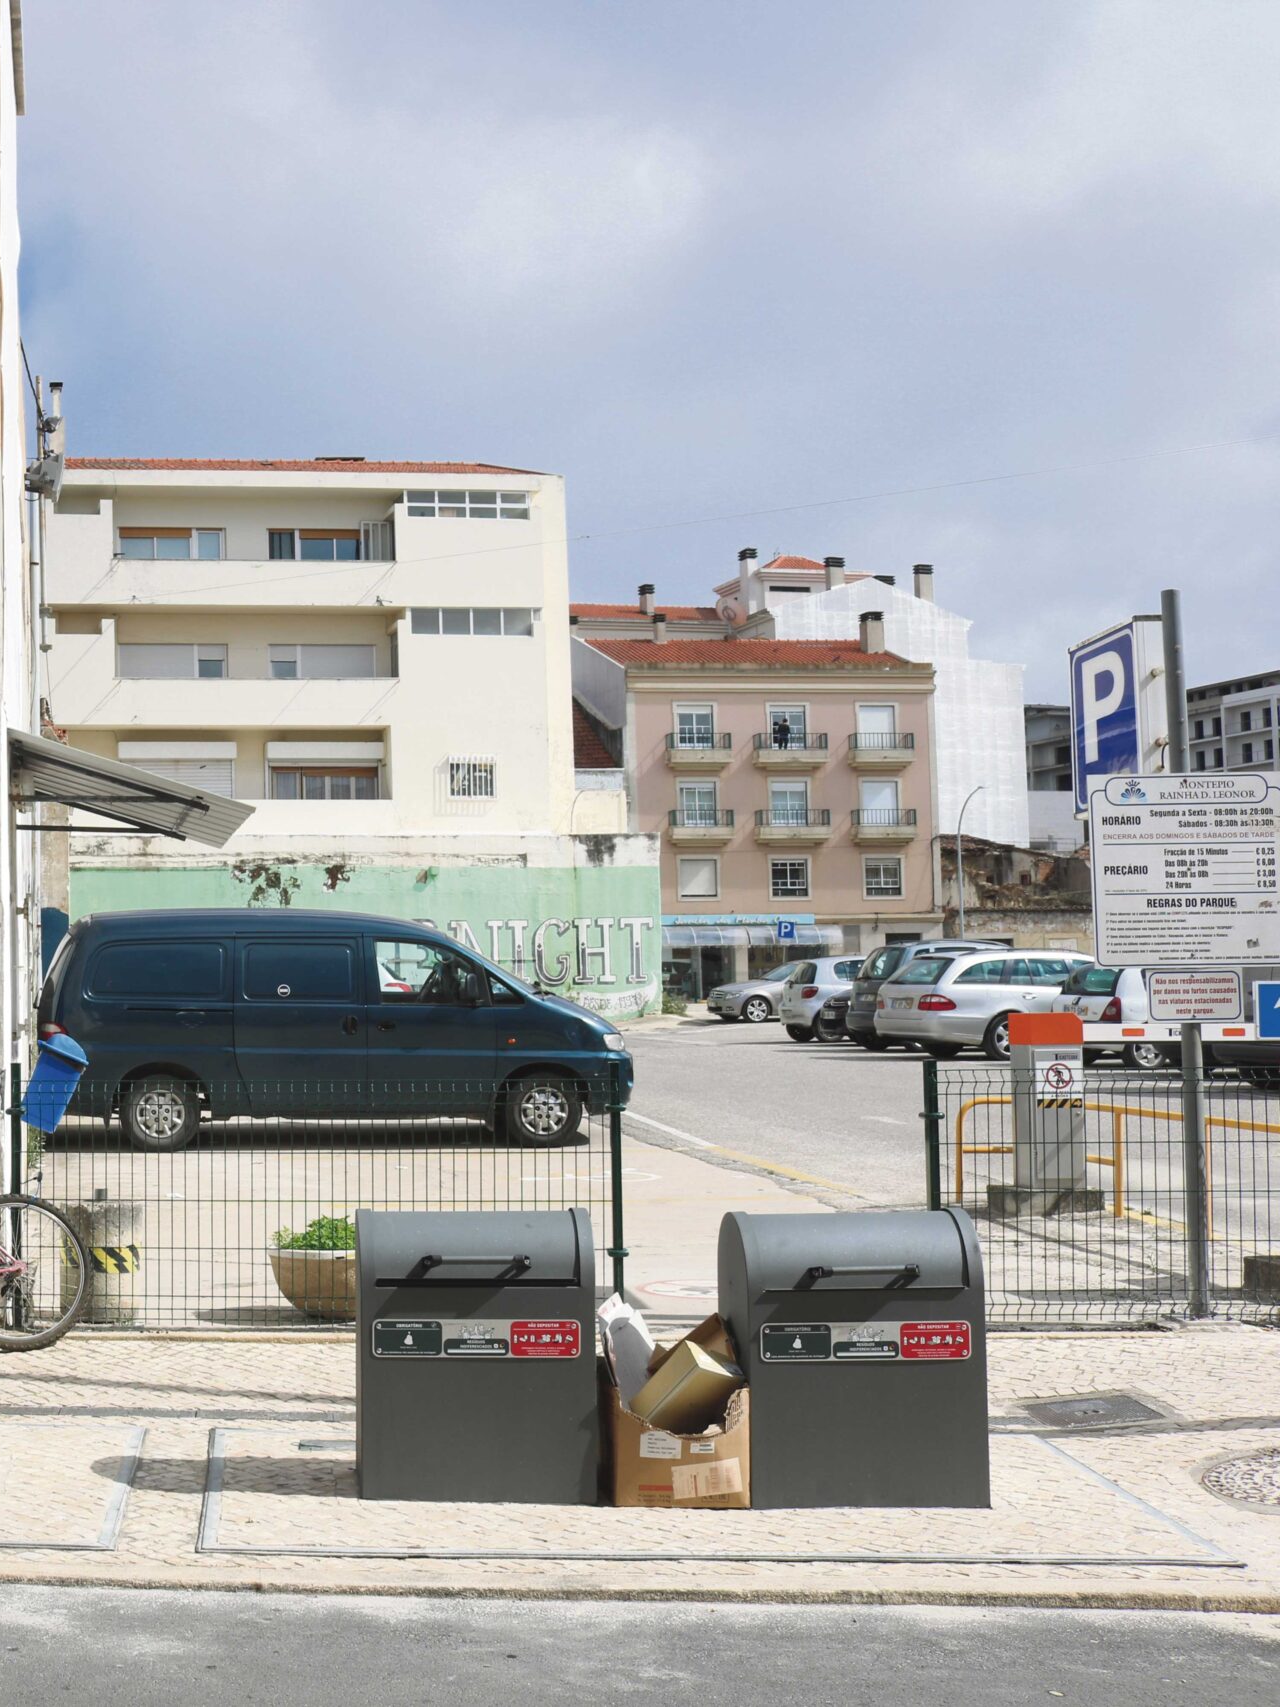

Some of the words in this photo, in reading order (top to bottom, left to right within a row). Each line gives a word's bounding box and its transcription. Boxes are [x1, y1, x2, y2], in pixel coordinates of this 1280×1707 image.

[1081, 650, 1125, 765] P
[1179, 780, 1235, 789] MONTEPIO
[1160, 791, 1199, 800] RAINHA
[1201, 791, 1211, 799] D.
[1213, 790, 1256, 799] LEONOR
[1150, 809, 1179, 818] Segunda
[1214, 808, 1238, 816] 08:00h
[1102, 814, 1141, 826] HORÁRIO
[1178, 820, 1208, 828] Sábados
[1164, 848, 1187, 857] Fracção
[1197, 859, 1208, 867] 20h
[1104, 864, 1148, 876] PREÇÁRIO
[1165, 881, 1173, 889] 24
[1175, 881, 1192, 889] Horas
[1146, 898, 1183, 908] REGRAS
[1185, 898, 1197, 908] DO
[1200, 897, 1236, 908] PARQUE
[781, 922, 791, 936] P
[1180, 977, 1234, 985] responsabilizamos
